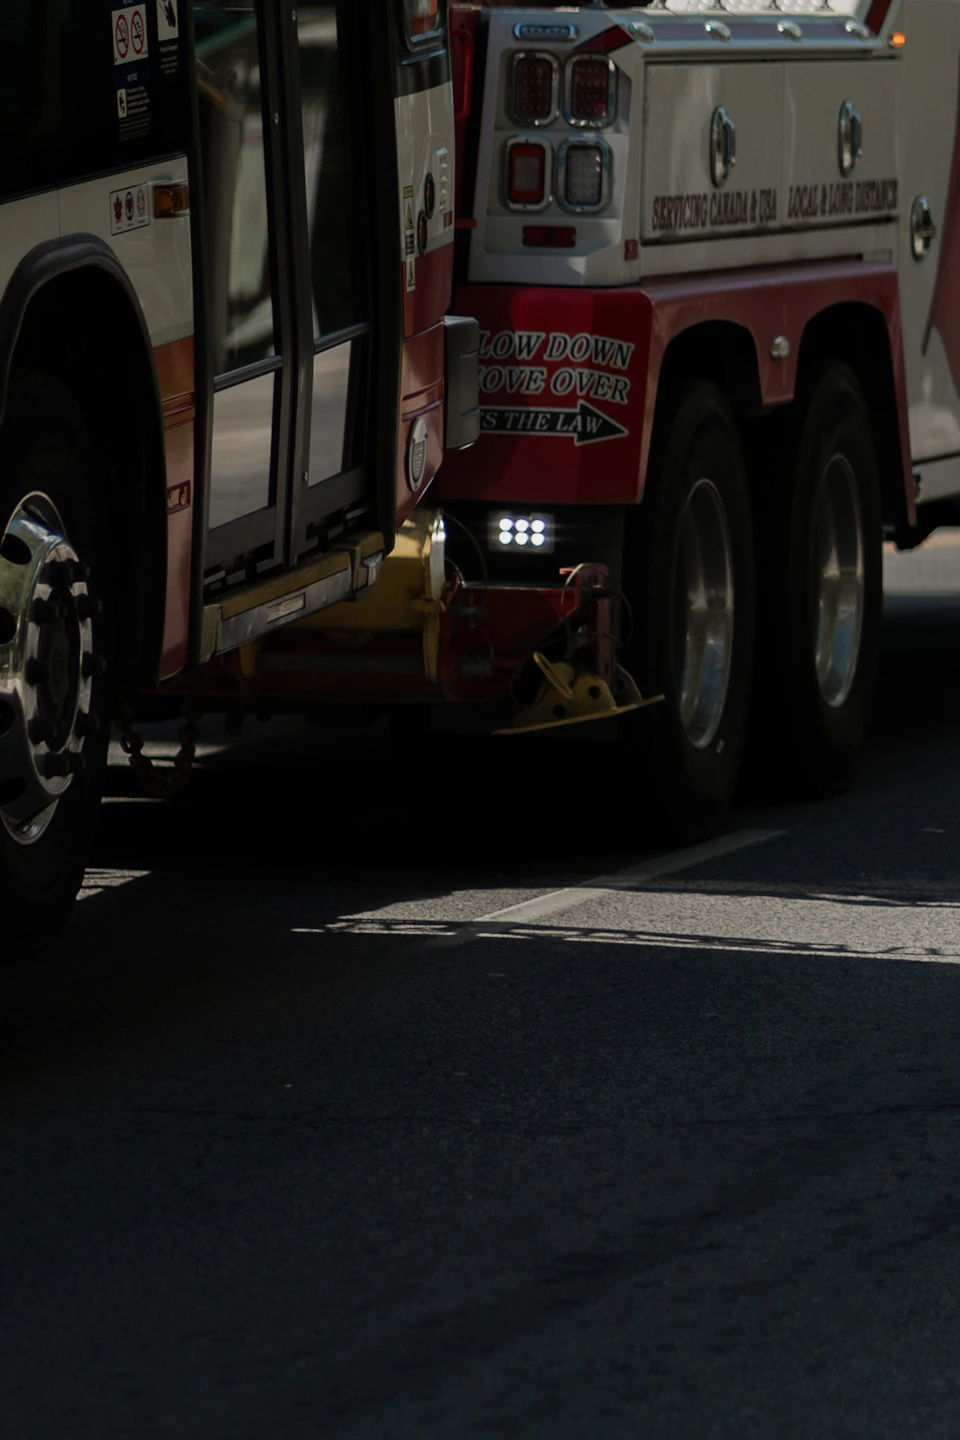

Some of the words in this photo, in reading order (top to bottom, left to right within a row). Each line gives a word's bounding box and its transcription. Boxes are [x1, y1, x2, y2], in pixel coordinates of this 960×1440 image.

[652, 193, 708, 231] SERVICING
[709, 190, 748, 227] CANADA
[750, 189, 758, 223] &
[759, 188, 777, 223] USA
[787, 183, 818, 219] LOCAL
[828, 180, 853, 216] LONG
[855, 178, 898, 213] DISTANCE
[478, 330, 546, 360] LOW
[544, 333, 635, 371] DOWN
[477, 366, 547, 394] OVE
[551, 367, 631, 405] OVER
[503, 411, 551, 430] THE
[556, 413, 604, 435] LAW
